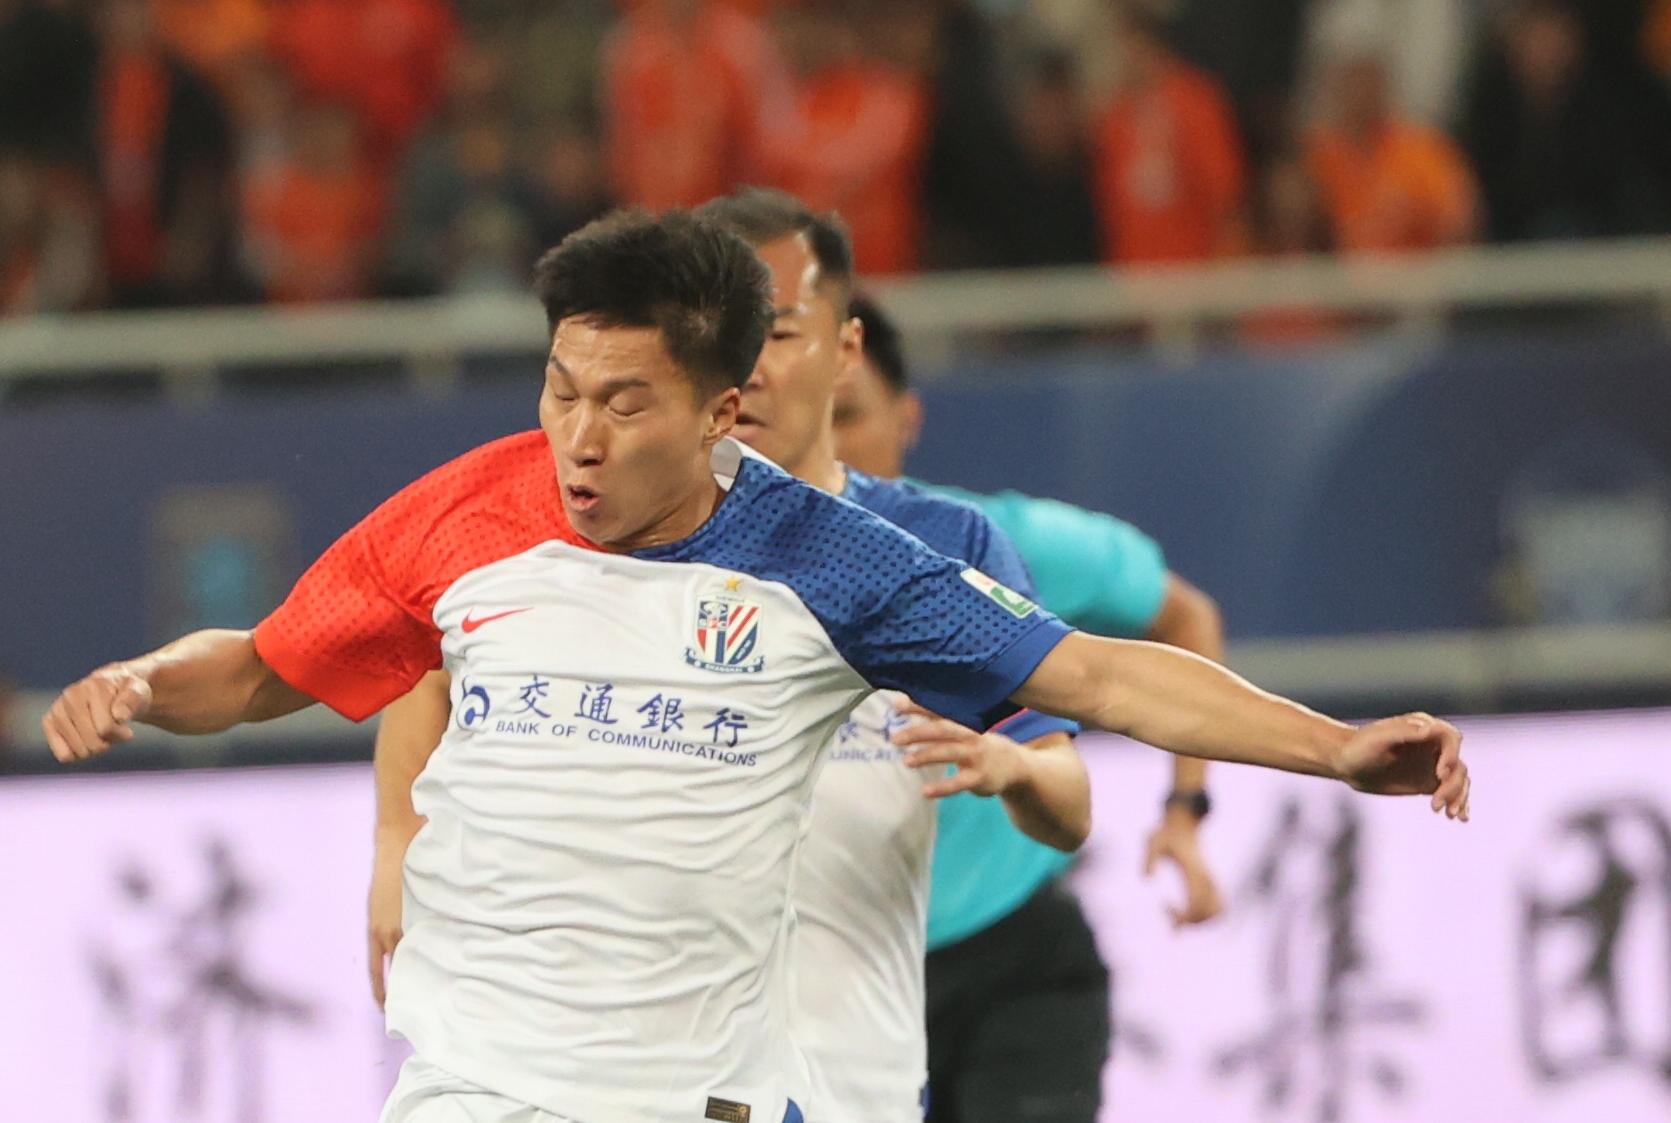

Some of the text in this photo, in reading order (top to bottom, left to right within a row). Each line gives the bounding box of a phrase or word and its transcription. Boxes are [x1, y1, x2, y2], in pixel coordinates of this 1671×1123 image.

[514, 674, 749, 748] 交通銀行
[495, 720, 757, 767] BANK OF COMMUNICATIONS
